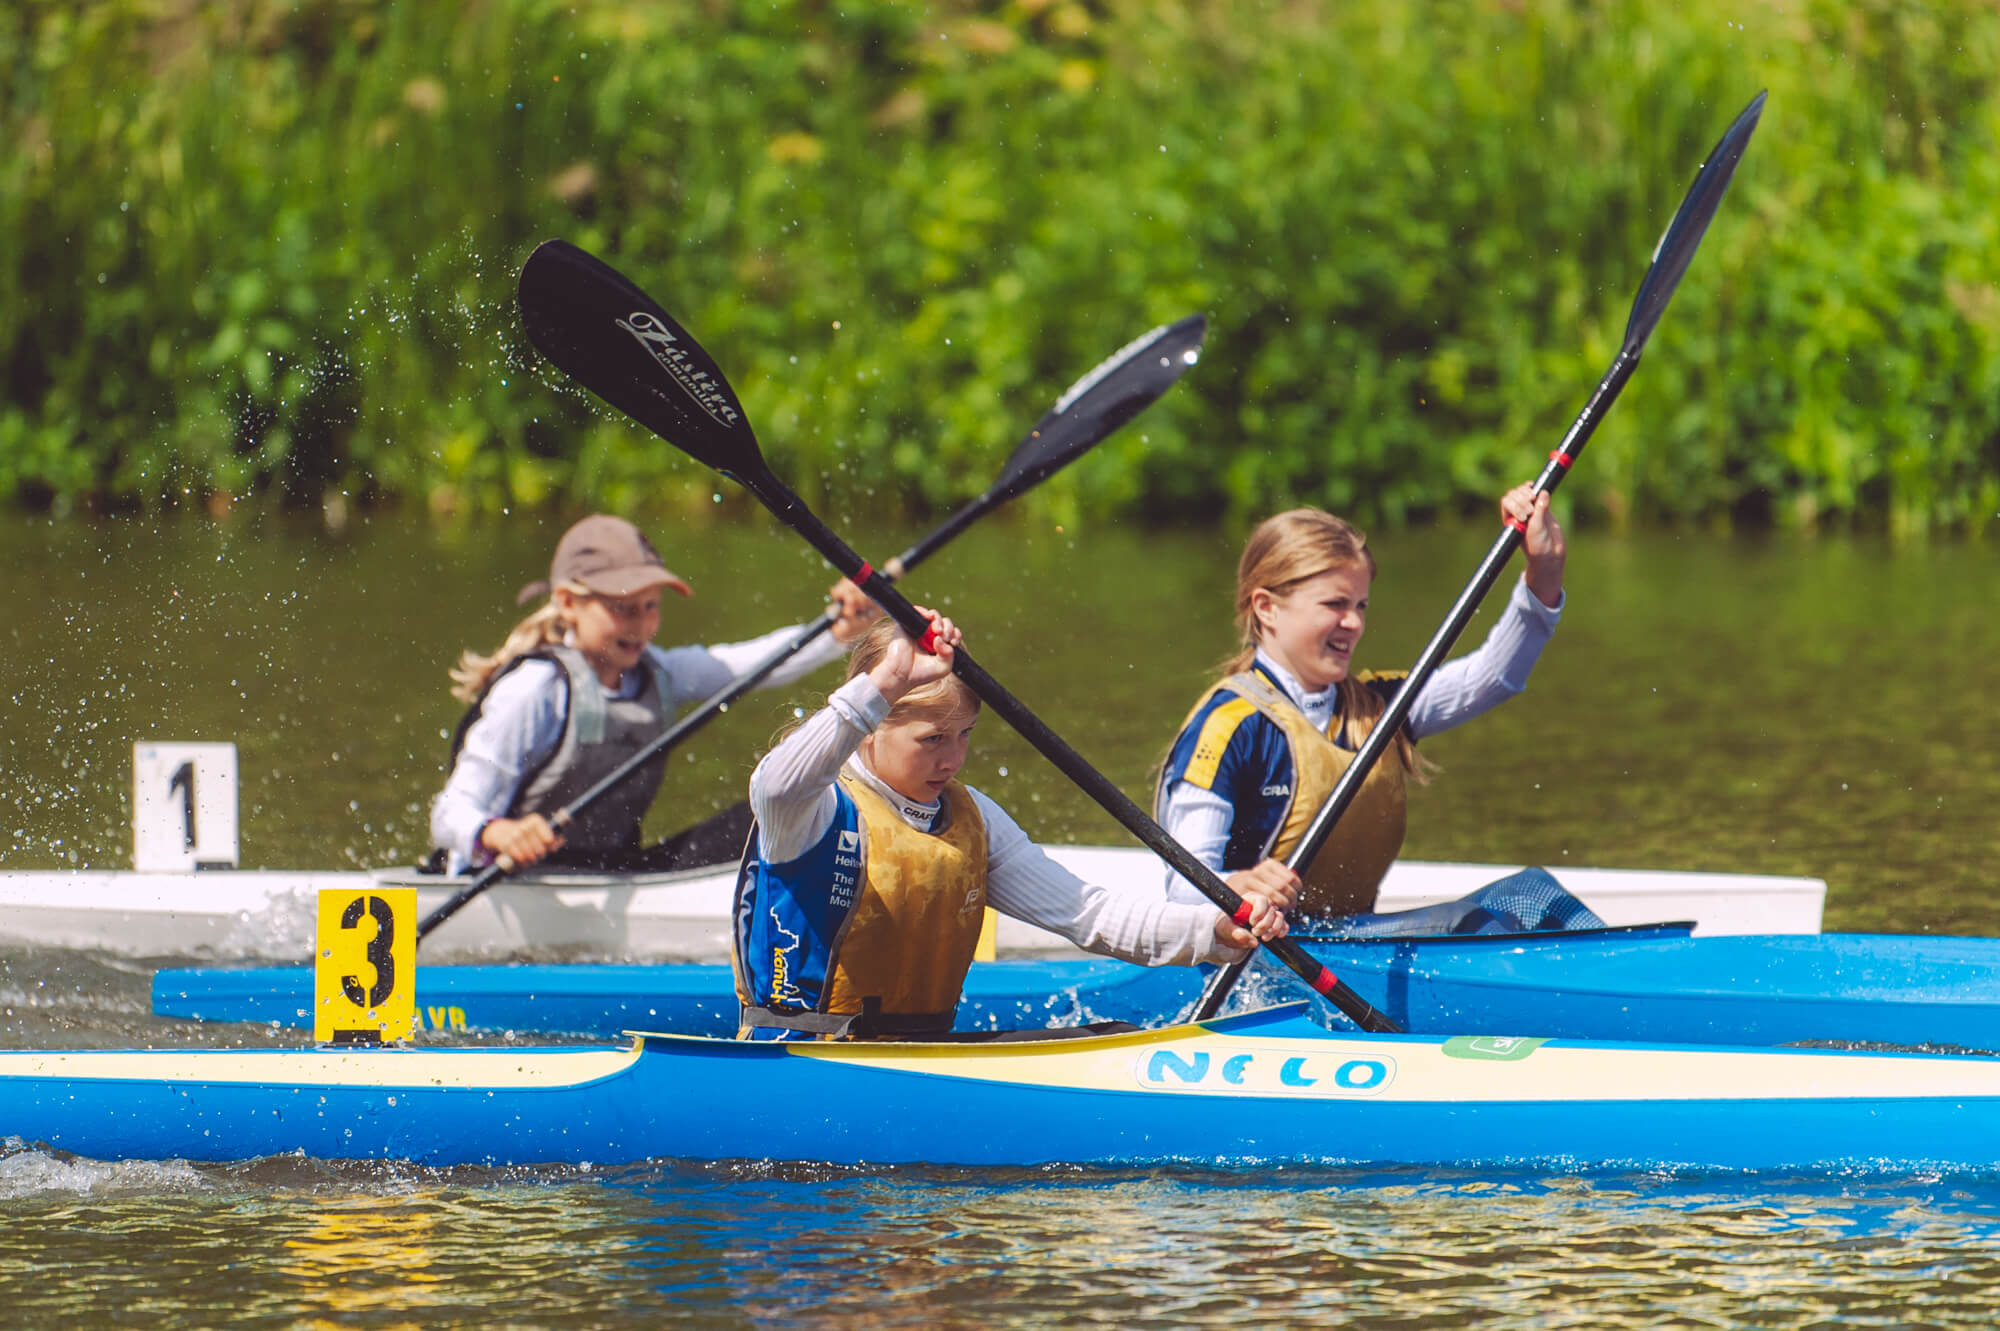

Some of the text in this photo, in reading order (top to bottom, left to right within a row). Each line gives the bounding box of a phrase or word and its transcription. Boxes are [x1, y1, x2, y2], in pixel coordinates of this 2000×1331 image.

[168, 761, 196, 849] 1
[833, 872, 855, 885] The
[341, 896, 395, 1008] 3
